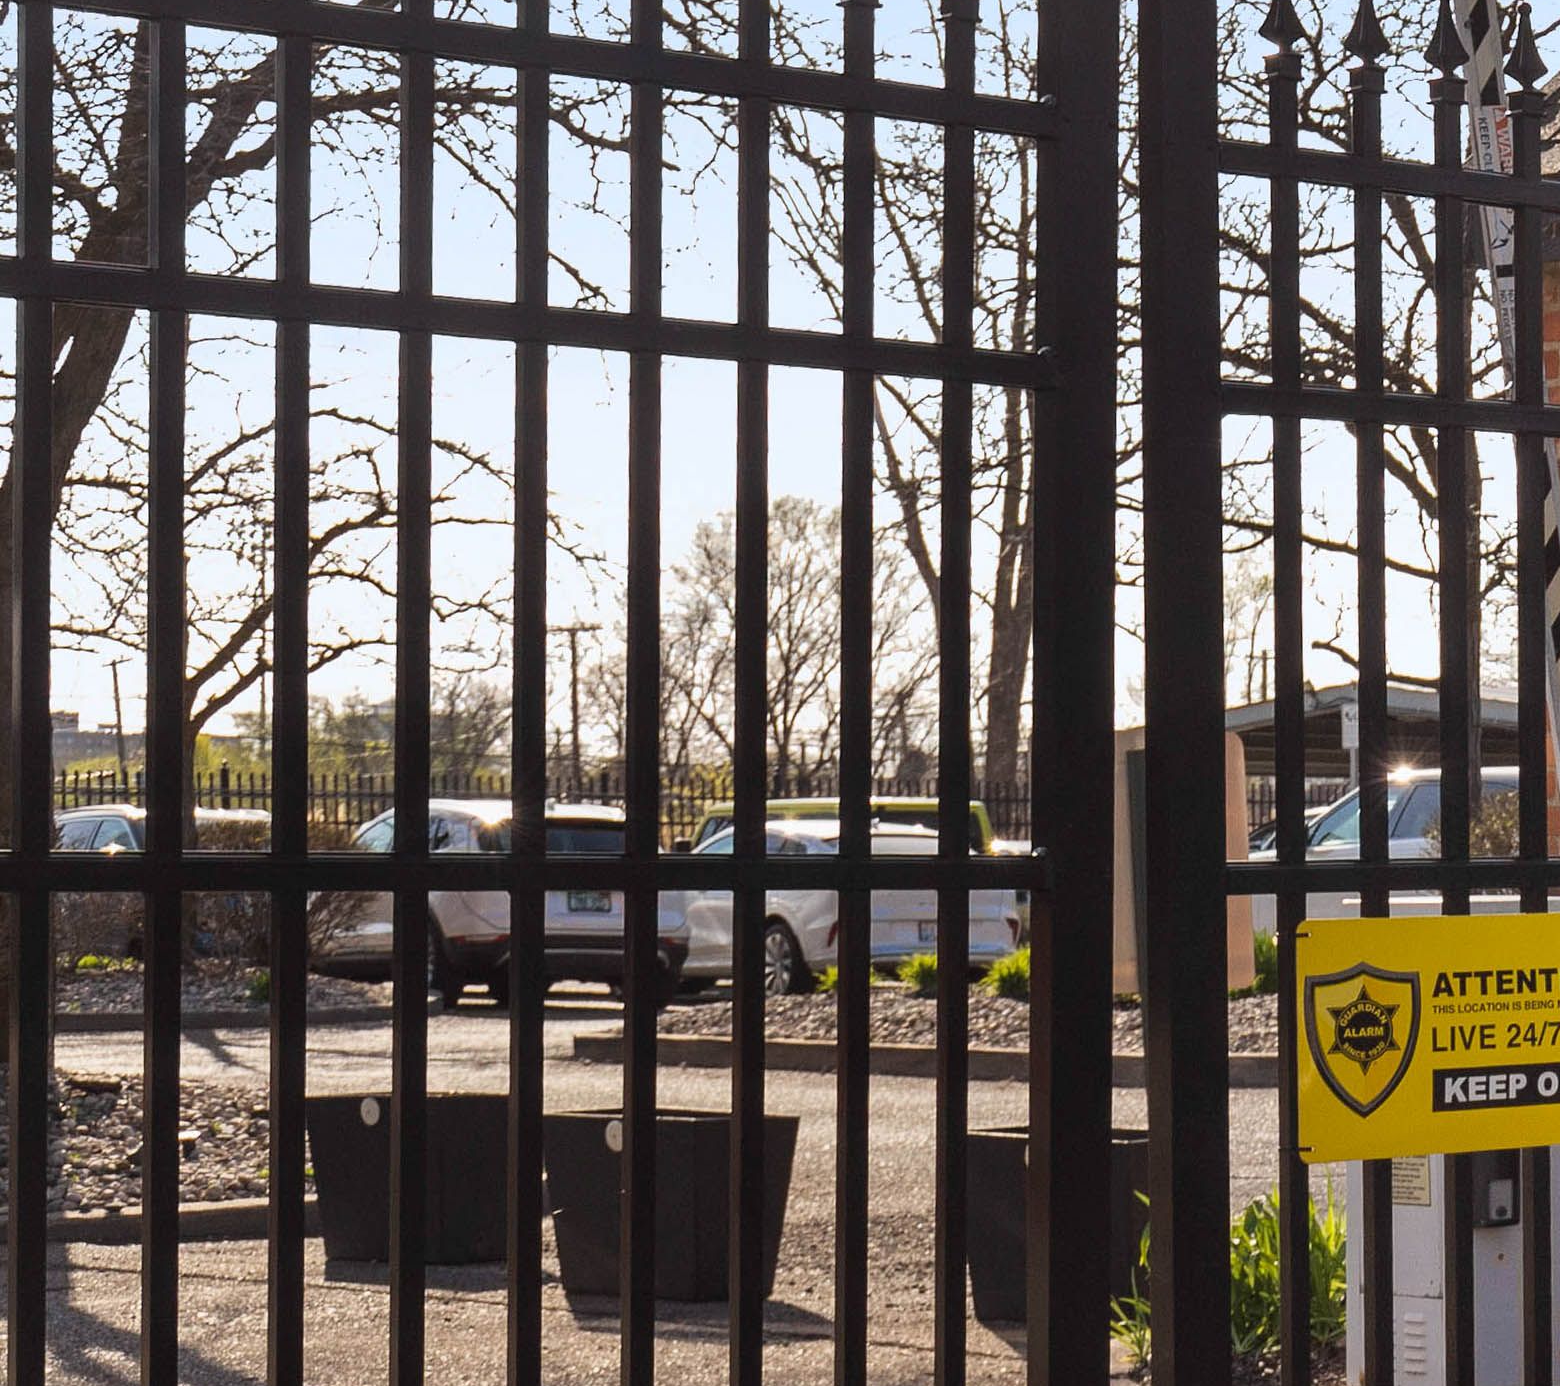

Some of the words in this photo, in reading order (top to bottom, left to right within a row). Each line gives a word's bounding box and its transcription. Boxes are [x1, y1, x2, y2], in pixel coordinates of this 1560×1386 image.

[1340, 1003, 1388, 1026] GUARDIAN
[1433, 1005, 1455, 1014] THIS
[1458, 1002, 1510, 1014] LOCATION
[1512, 1001, 1522, 1011] IS
[1524, 1000, 1555, 1010] BEING
[1343, 1027, 1384, 1038] ALARM
[1432, 1024, 1497, 1052] LIVE
[1444, 1073, 1528, 1103] KEEP
